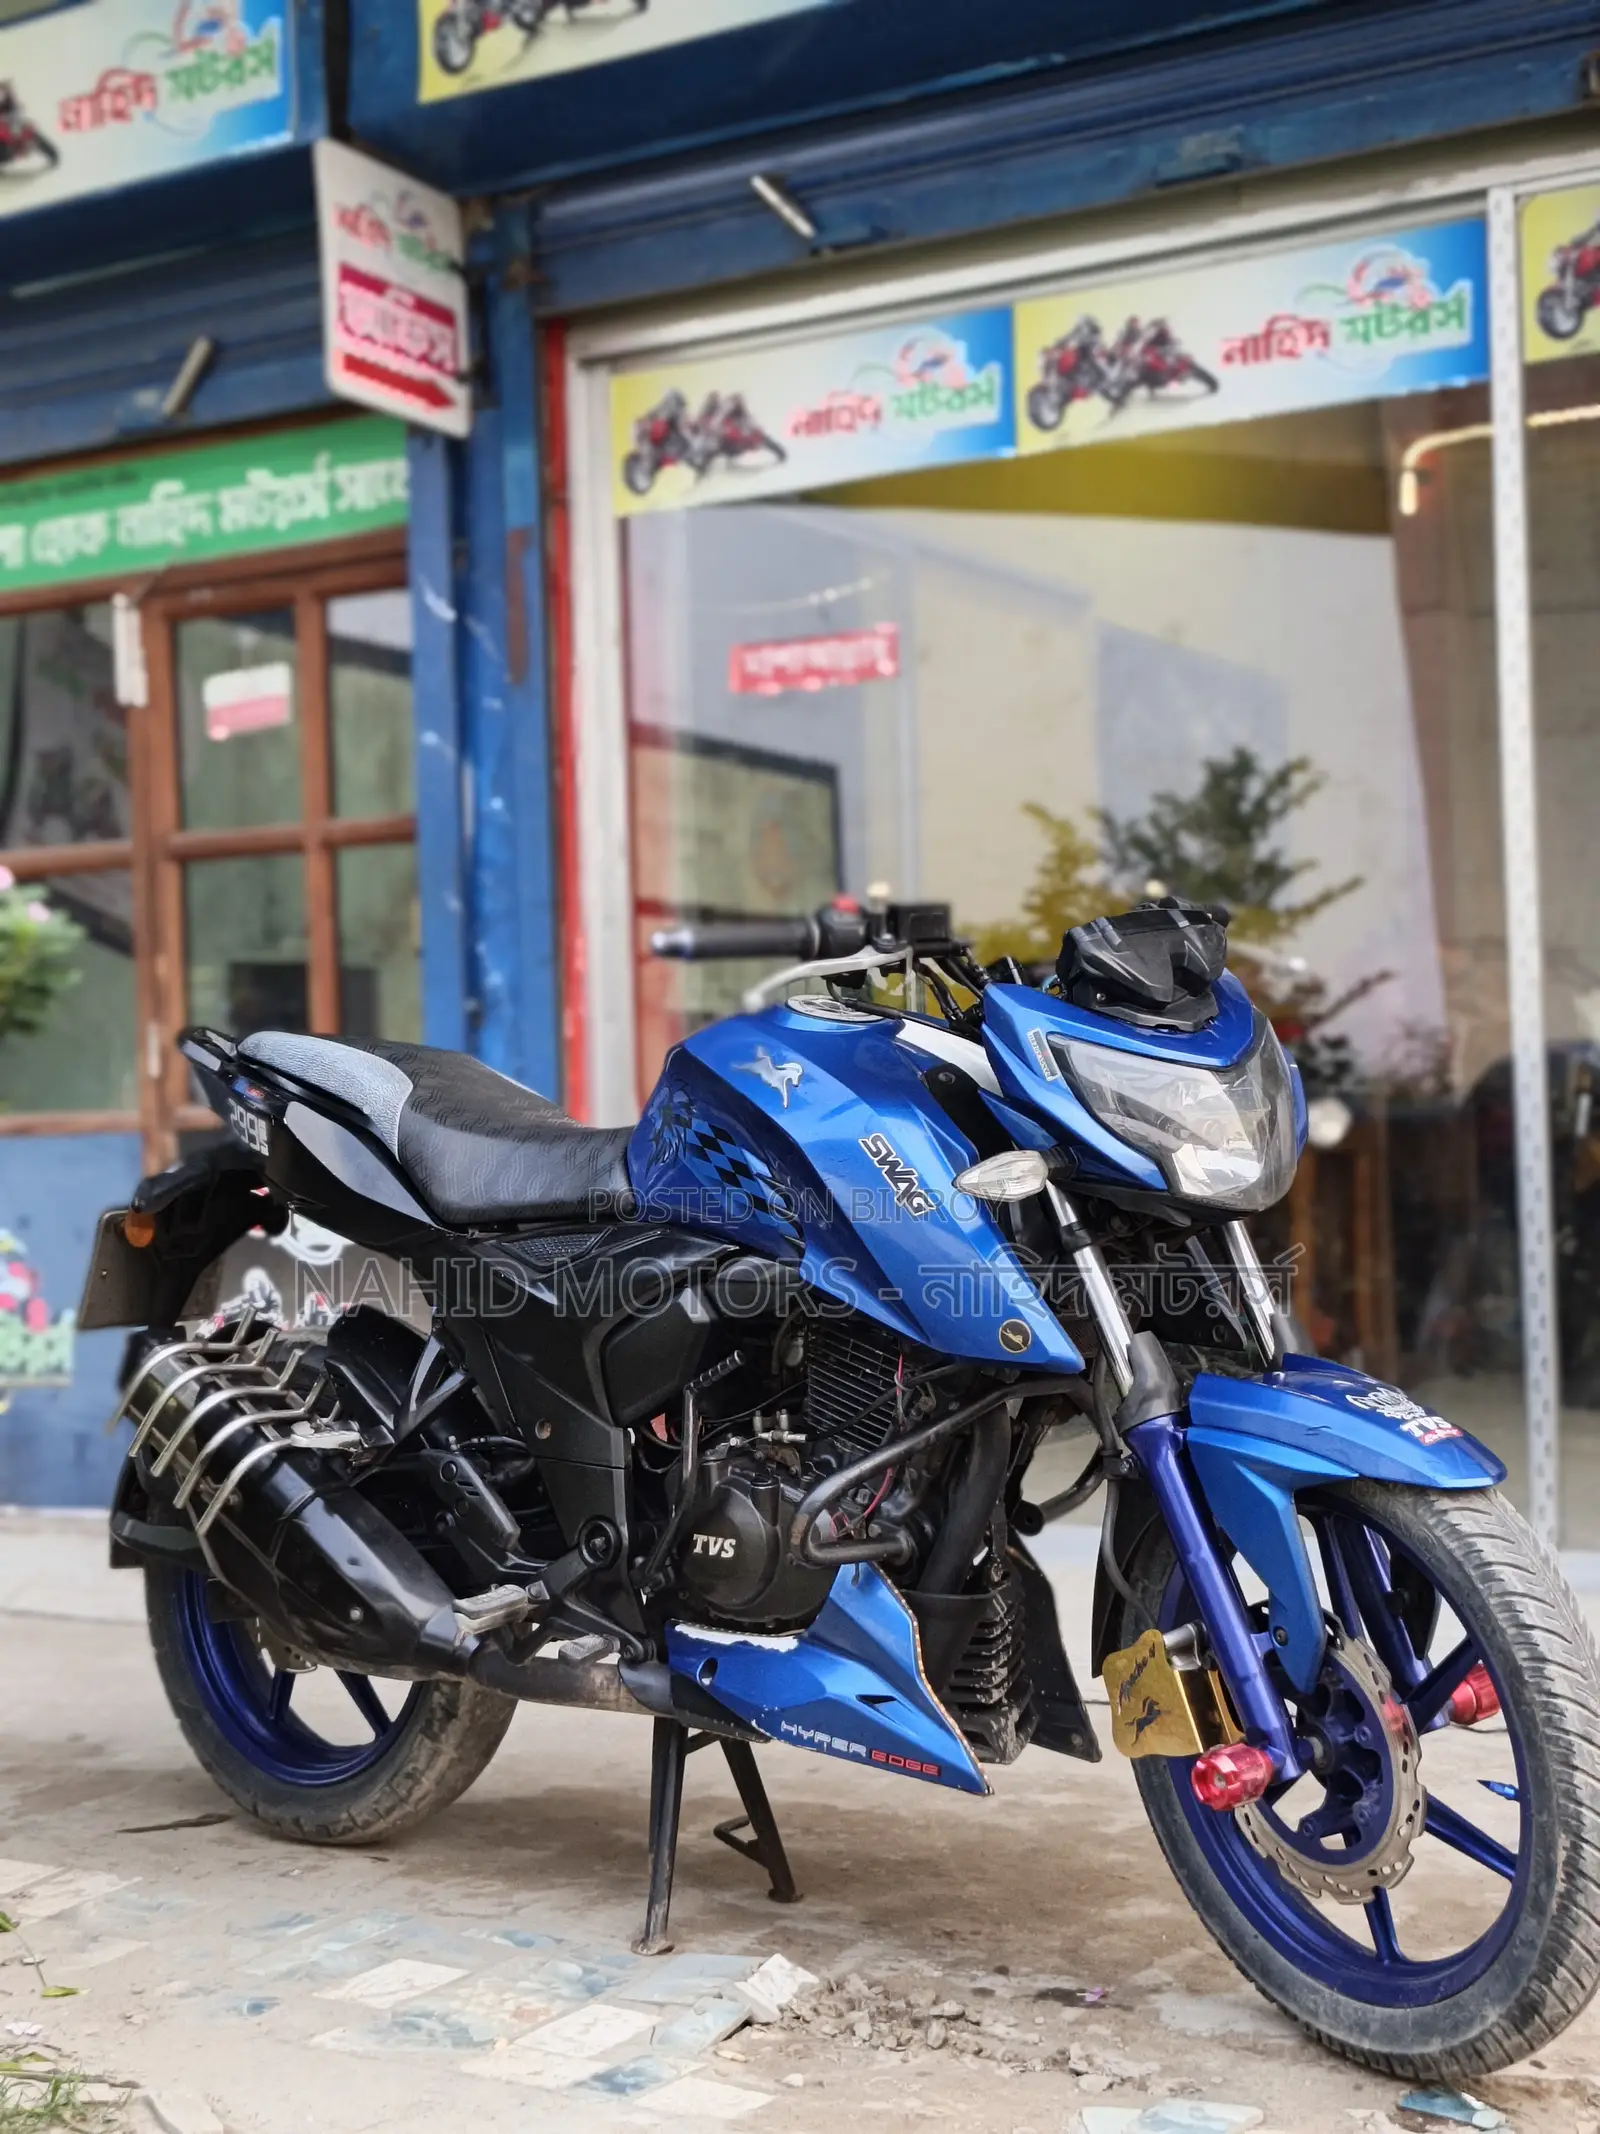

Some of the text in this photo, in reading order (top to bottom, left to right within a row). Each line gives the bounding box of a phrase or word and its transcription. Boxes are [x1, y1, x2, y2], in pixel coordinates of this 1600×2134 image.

[1220, 314, 1330, 365] নাহিদ
[858, 1132, 936, 1216] SWAG
[1400, 1416, 1452, 1438] TVS
[692, 1533, 736, 1558] TVS
[780, 1720, 940, 1776] HYPER EDGE
